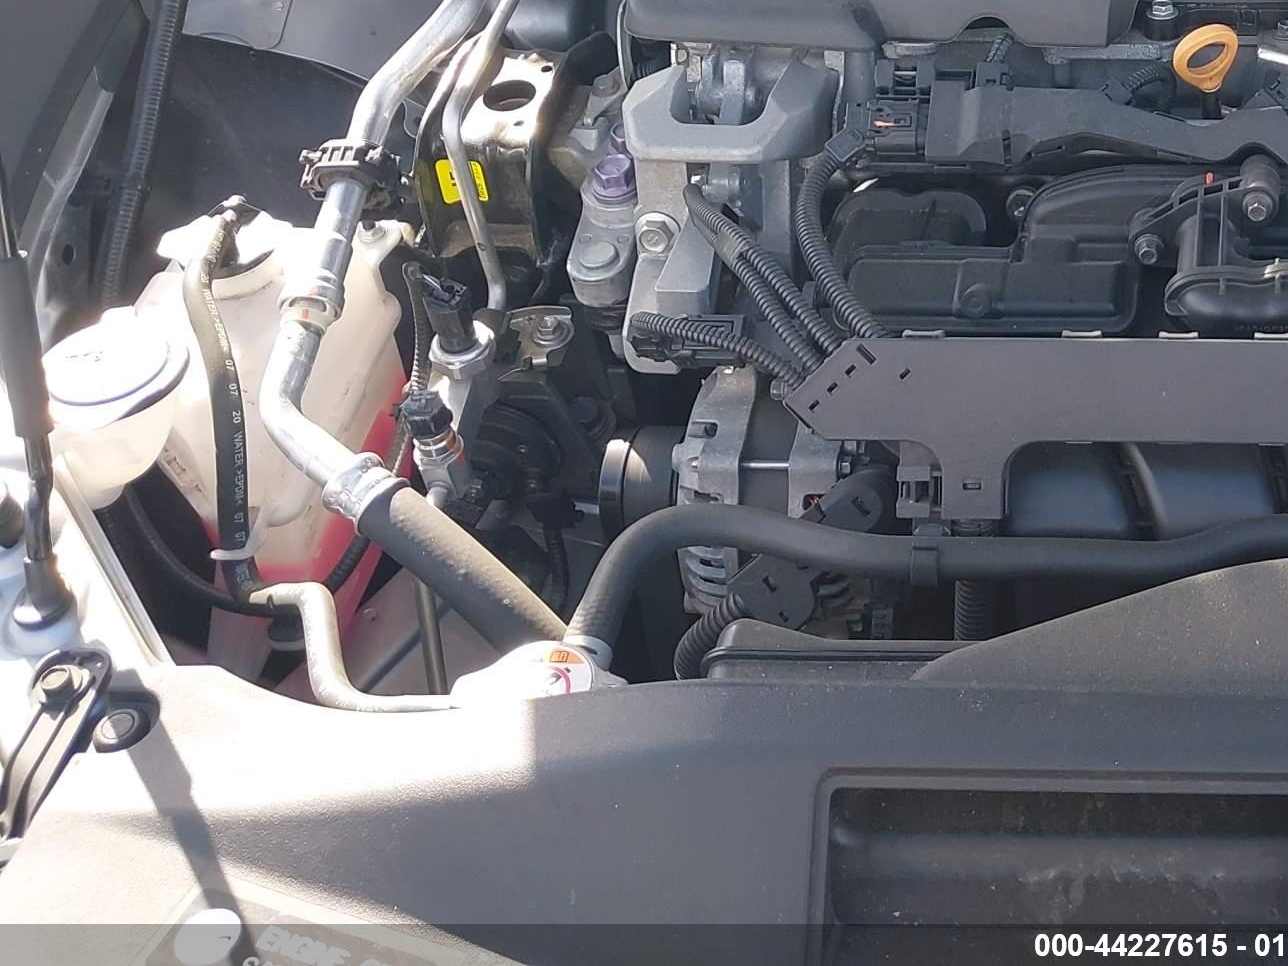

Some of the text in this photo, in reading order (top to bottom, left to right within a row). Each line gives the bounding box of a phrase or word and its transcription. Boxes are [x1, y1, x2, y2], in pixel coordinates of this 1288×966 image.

[201, 288, 216, 315] WATER
[225, 359, 234, 371] 07
[228, 383, 238, 396] 07
[232, 410, 241, 423] 20
[233, 431, 244, 467] WATER
